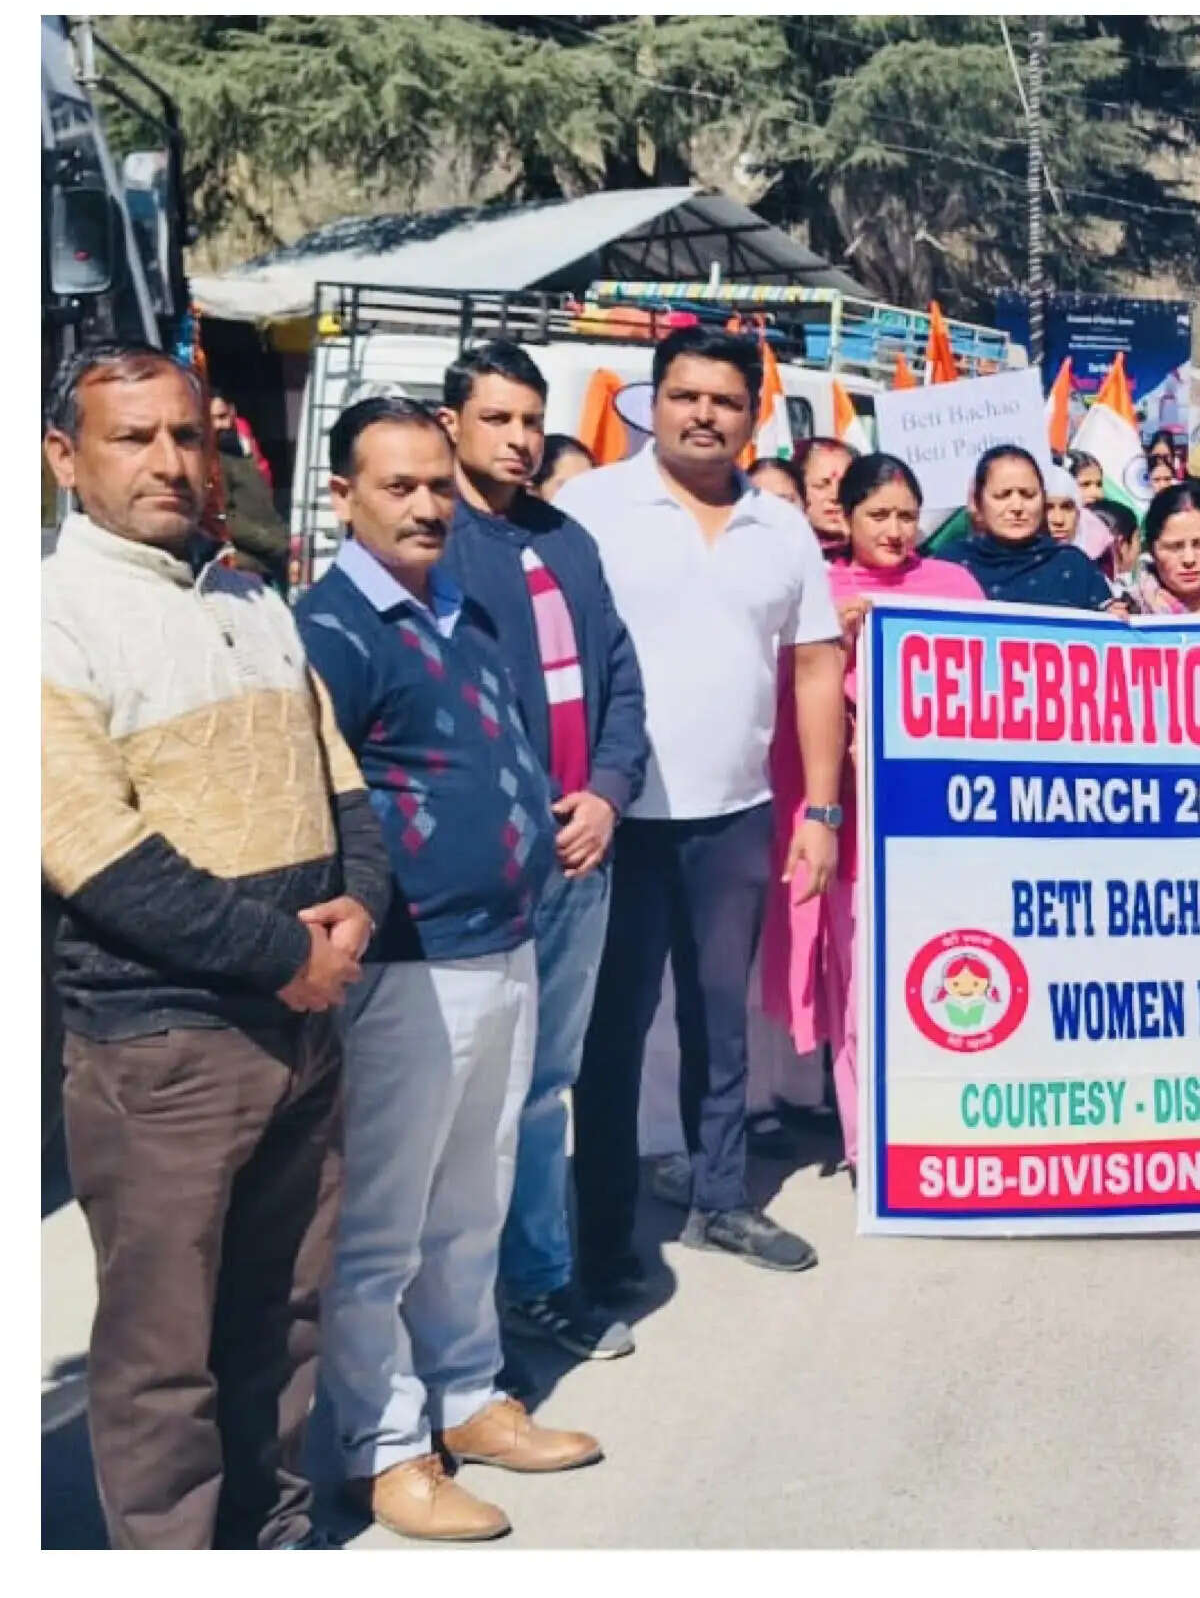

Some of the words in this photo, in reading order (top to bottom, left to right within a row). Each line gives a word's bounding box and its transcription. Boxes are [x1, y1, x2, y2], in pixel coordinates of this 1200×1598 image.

[947, 774, 998, 823] 02
[1010, 775, 1161, 823] MARCH
[1012, 879, 1095, 937] BETI
[1048, 980, 1185, 1042] WOMEN
[960, 1080, 1127, 1130] COURTESY
